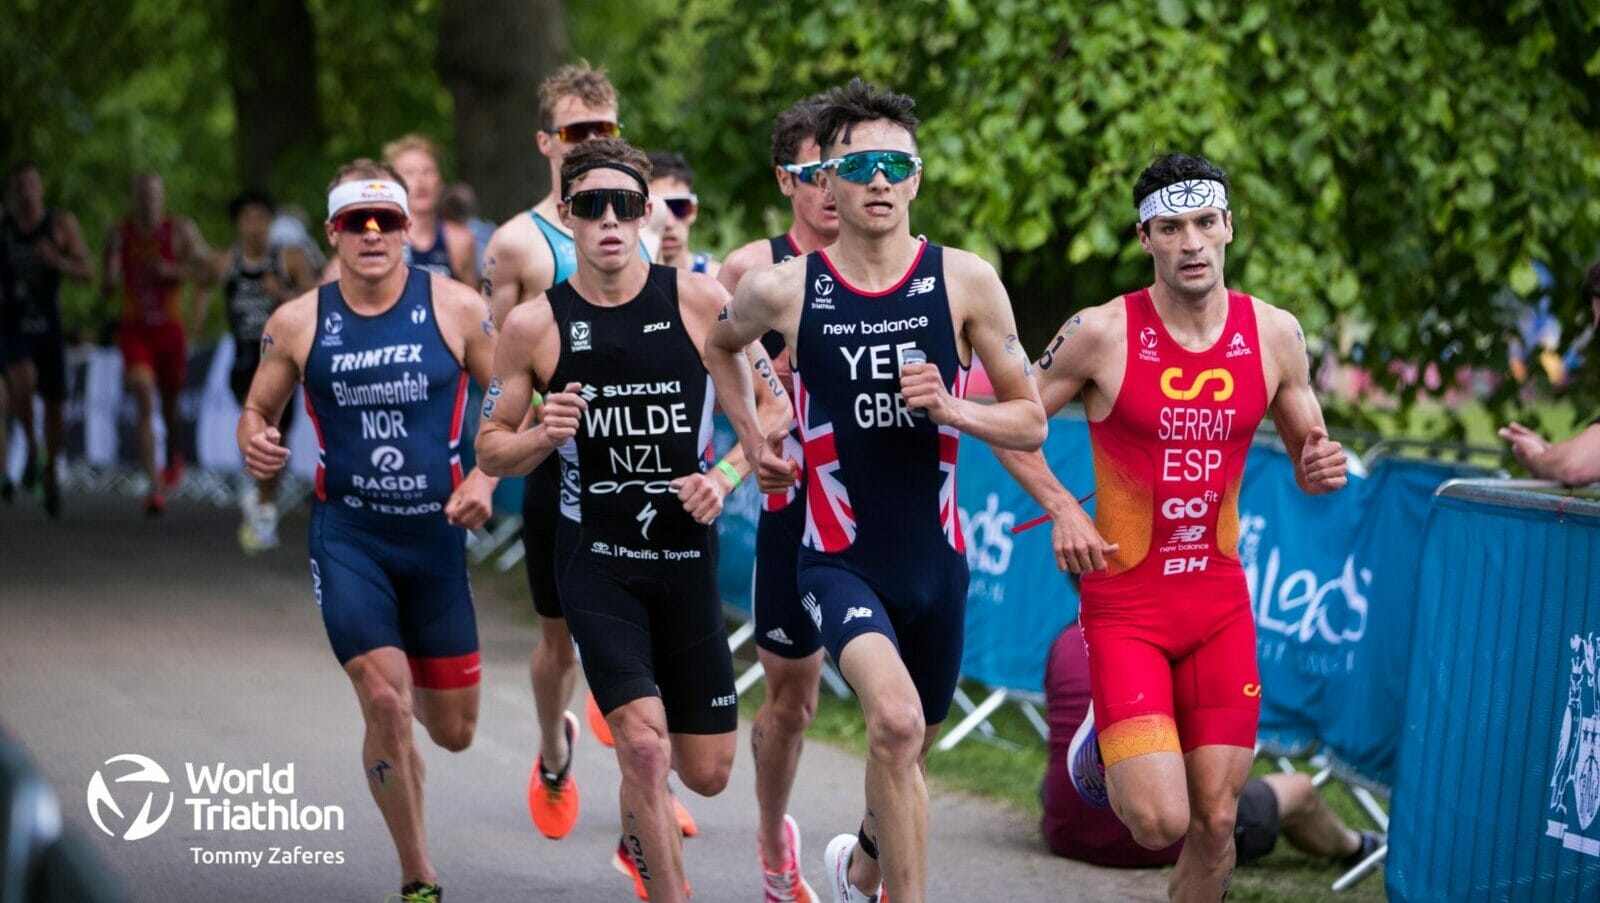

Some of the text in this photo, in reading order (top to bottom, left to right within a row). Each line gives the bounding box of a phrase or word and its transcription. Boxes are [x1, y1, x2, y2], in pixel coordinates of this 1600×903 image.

[823, 316, 929, 335] new balance
[331, 344, 423, 373] TRIMTEX
[332, 371, 429, 407] Blummenfelt
[602, 380, 681, 397] SUZUKI
[584, 402, 692, 438] WILDE
[854, 392, 915, 429] GBR
[1158, 406, 1236, 441] SERRAT
[361, 410, 408, 440] NOR
[609, 444, 673, 474] NZL
[1162, 448, 1222, 481] ESP
[352, 474, 428, 491] RAGDE
[369, 501, 442, 515] TEXACO
[1161, 497, 1208, 520] GO
[619, 546, 660, 560] Pacific
[663, 549, 701, 561] Toyota
[1160, 543, 1209, 553] new balance
[1163, 556, 1209, 576] BH
